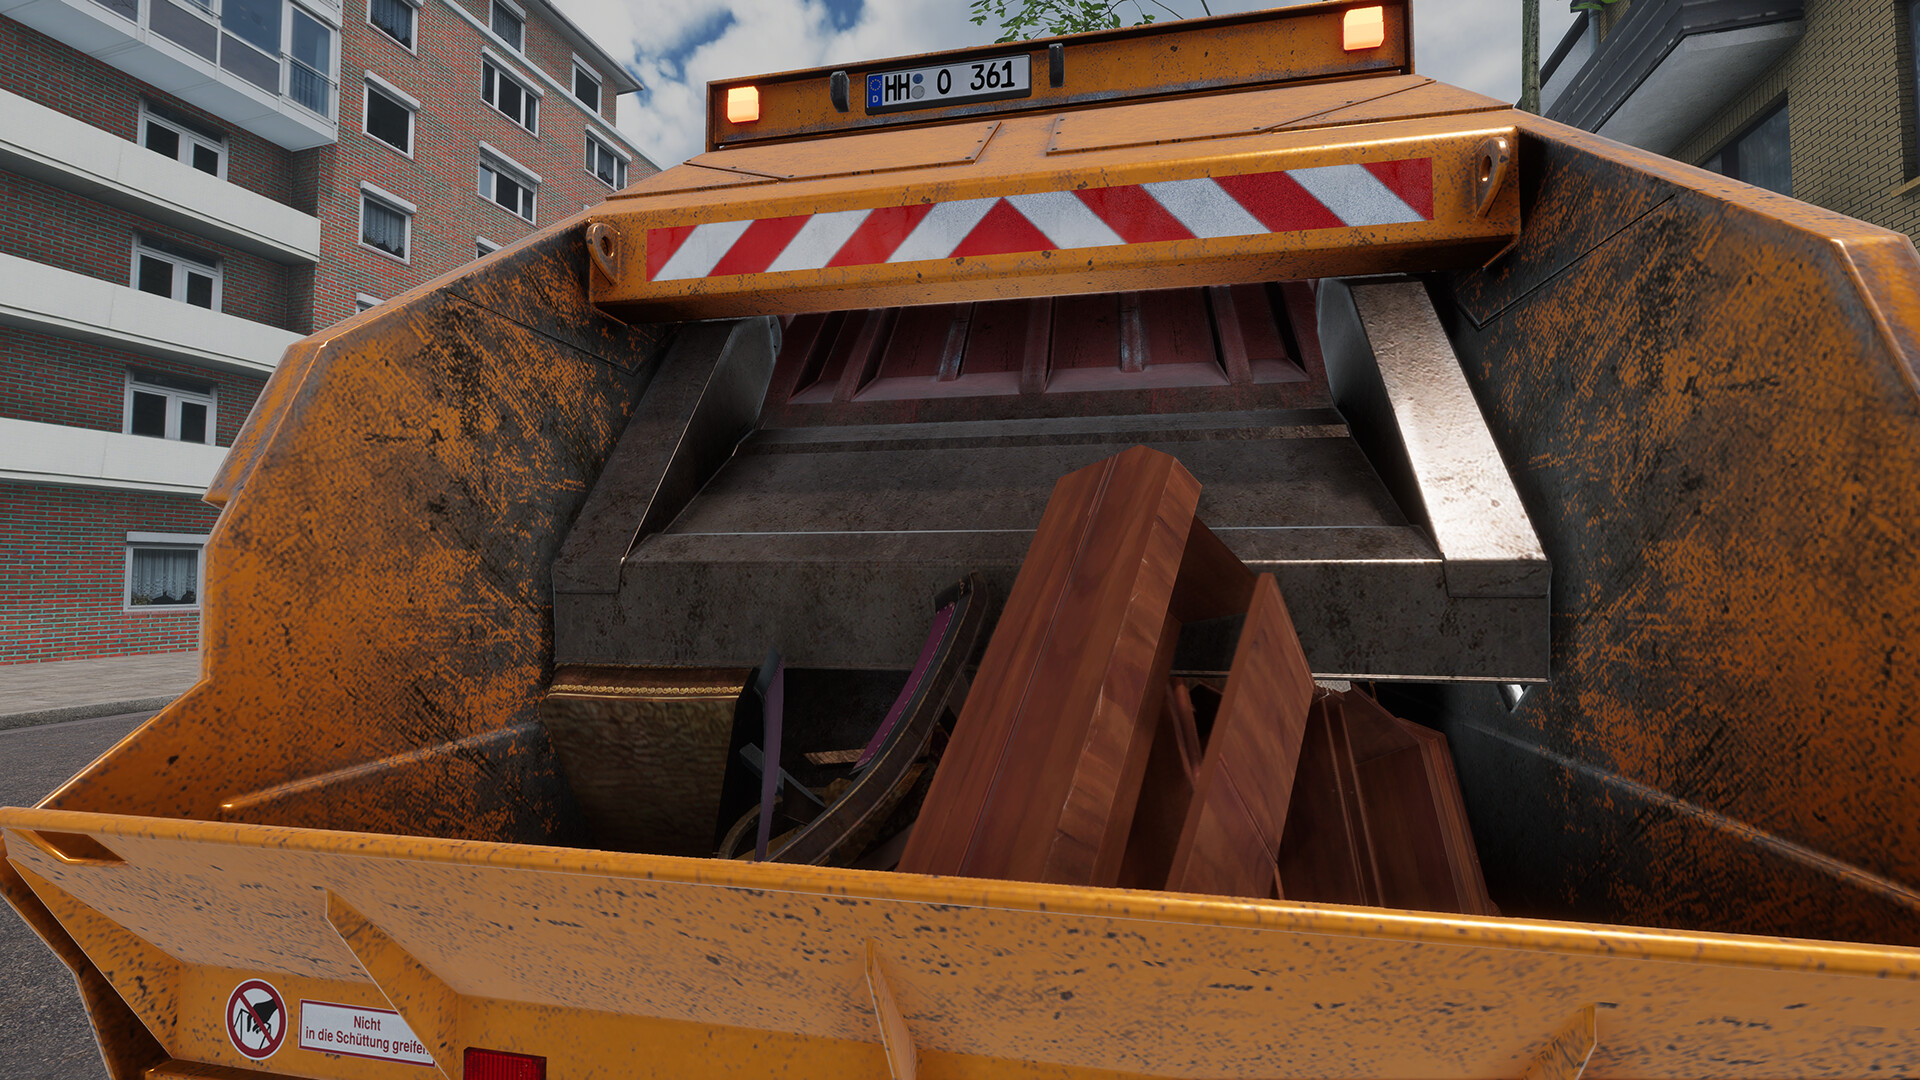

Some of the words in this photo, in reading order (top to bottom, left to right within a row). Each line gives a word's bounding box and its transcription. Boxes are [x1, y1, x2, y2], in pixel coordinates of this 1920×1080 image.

[884, 73, 910, 102] HH
[970, 60, 1015, 91] 361
[353, 1015, 381, 1032] Nicht
[305, 1026, 315, 1040] in
[317, 1028, 334, 1042] die
[336, 1030, 390, 1053] Schüttung
